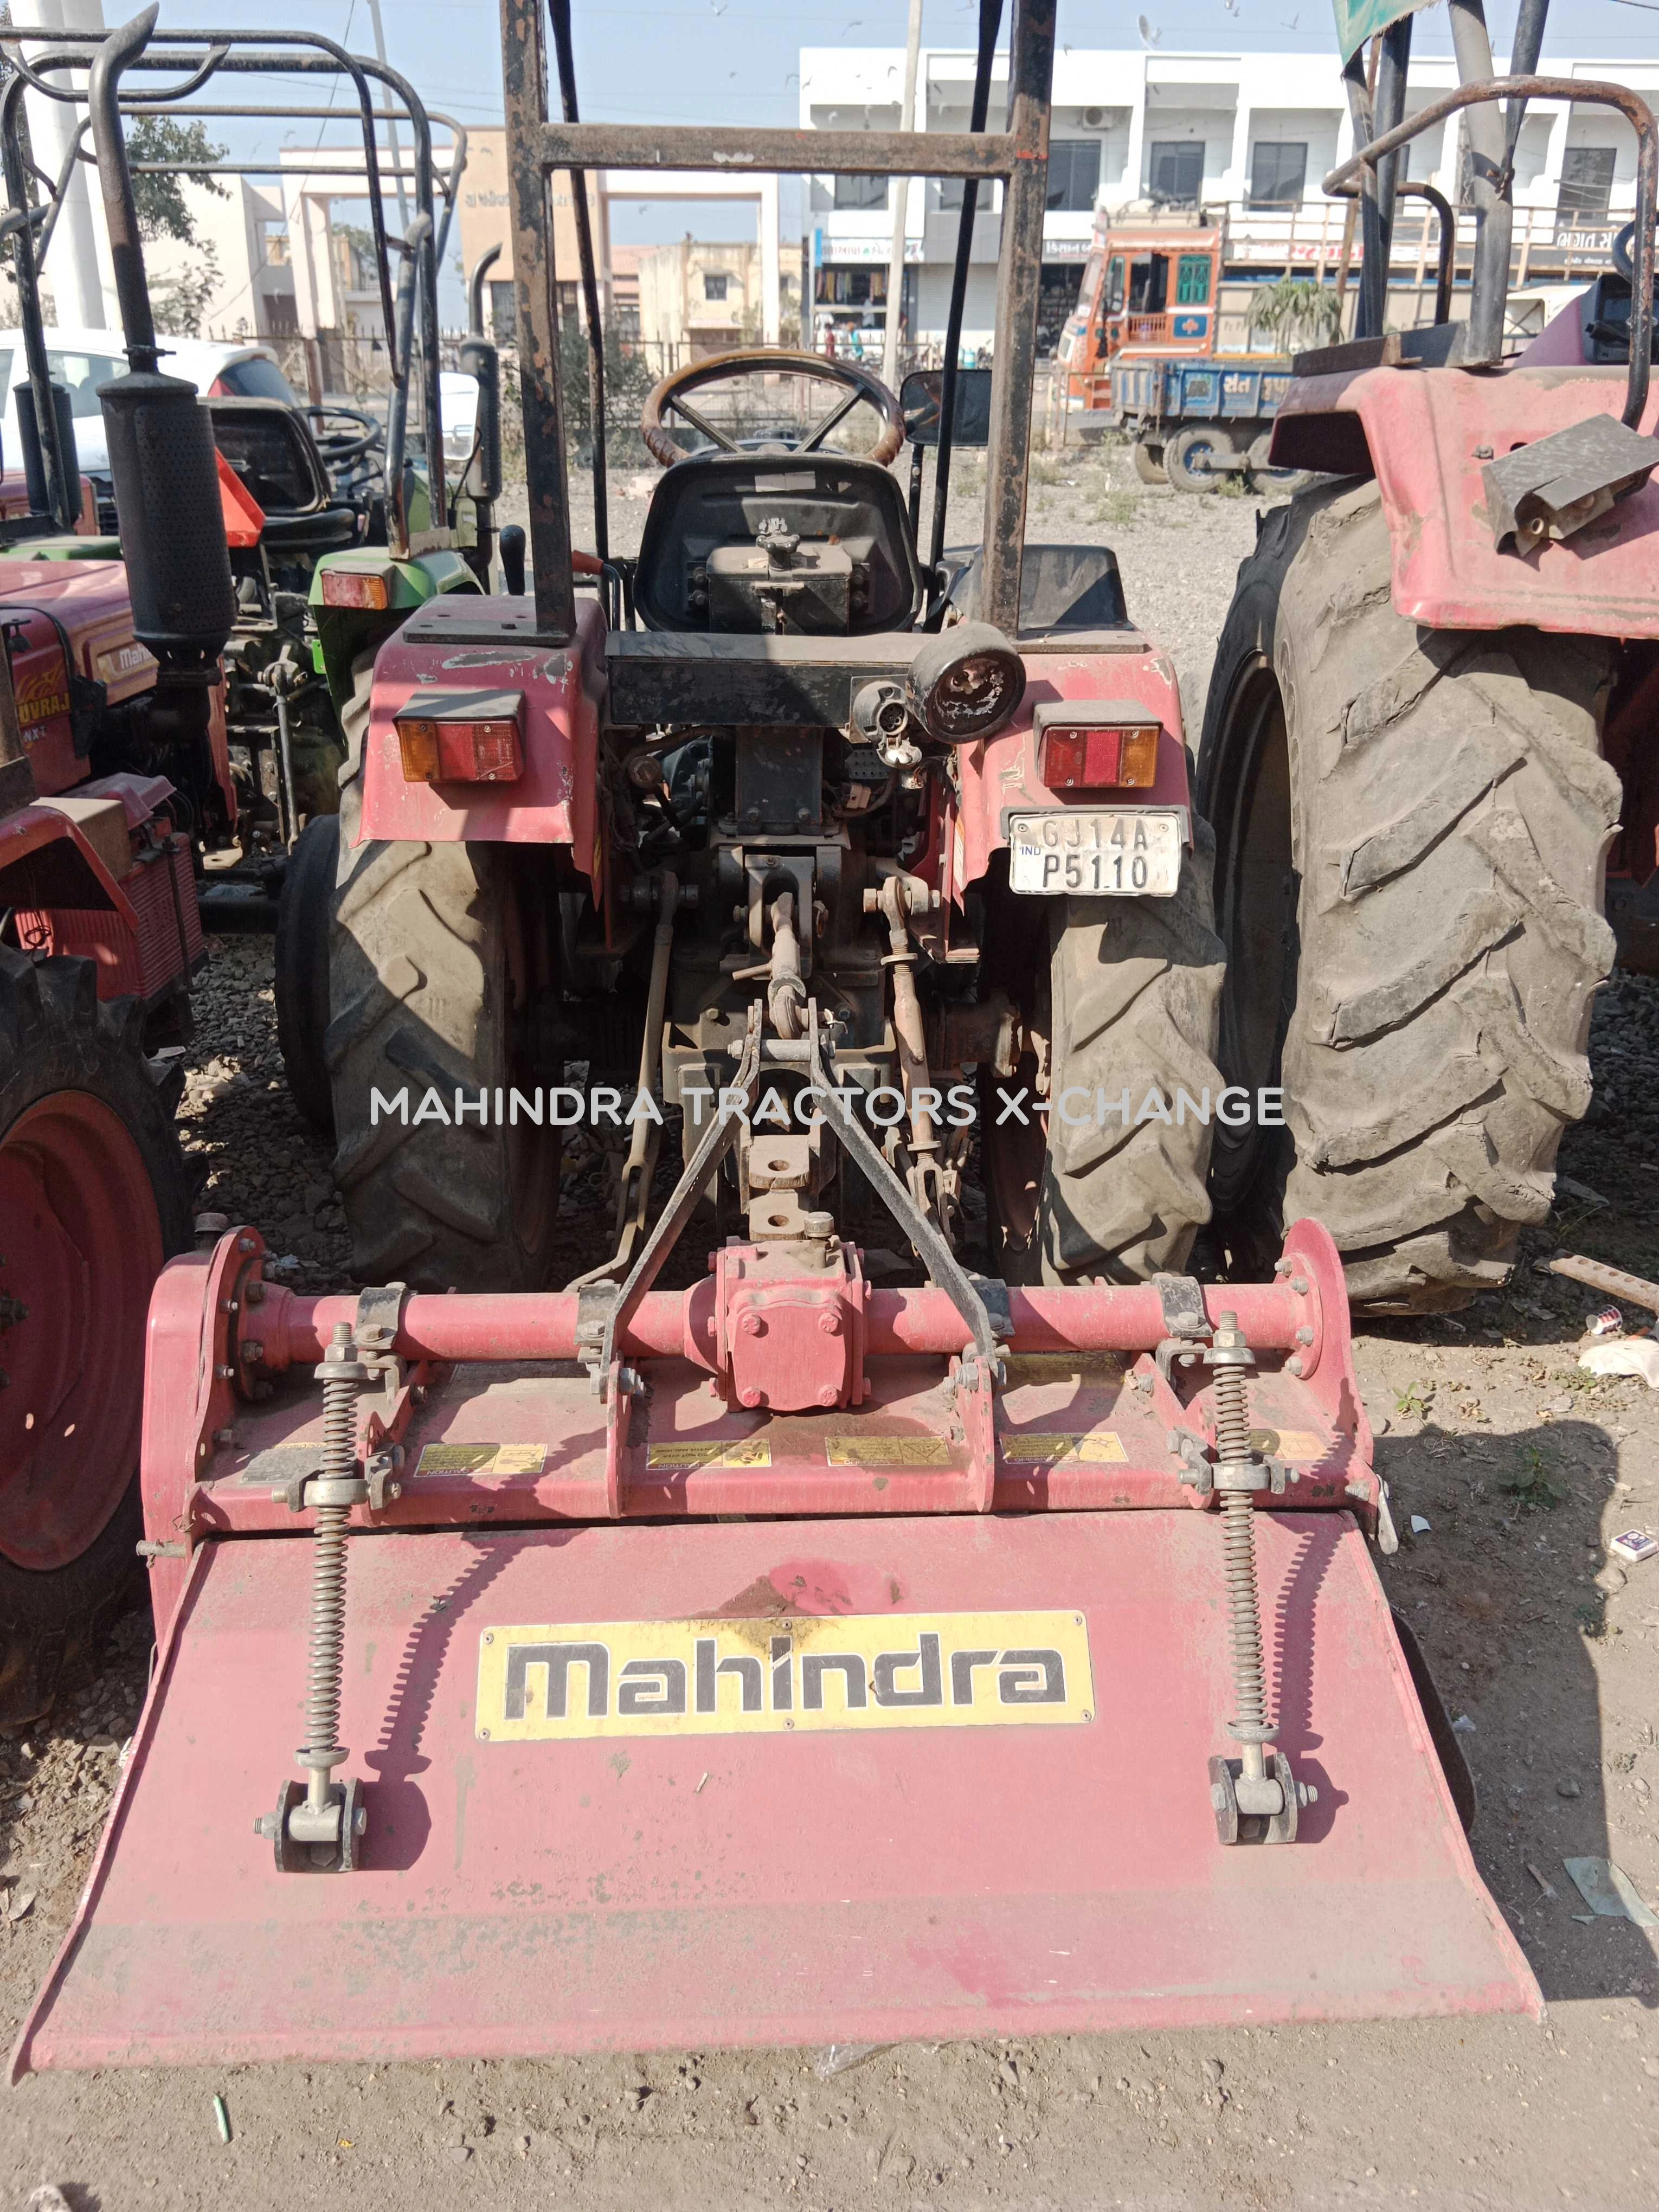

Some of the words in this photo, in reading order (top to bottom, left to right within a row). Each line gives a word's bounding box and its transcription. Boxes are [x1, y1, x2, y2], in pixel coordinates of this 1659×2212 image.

[18, 692, 70, 724] UVRAJ
[1021, 846, 1041, 856] IND
[1043, 854, 1148, 889] P5110
